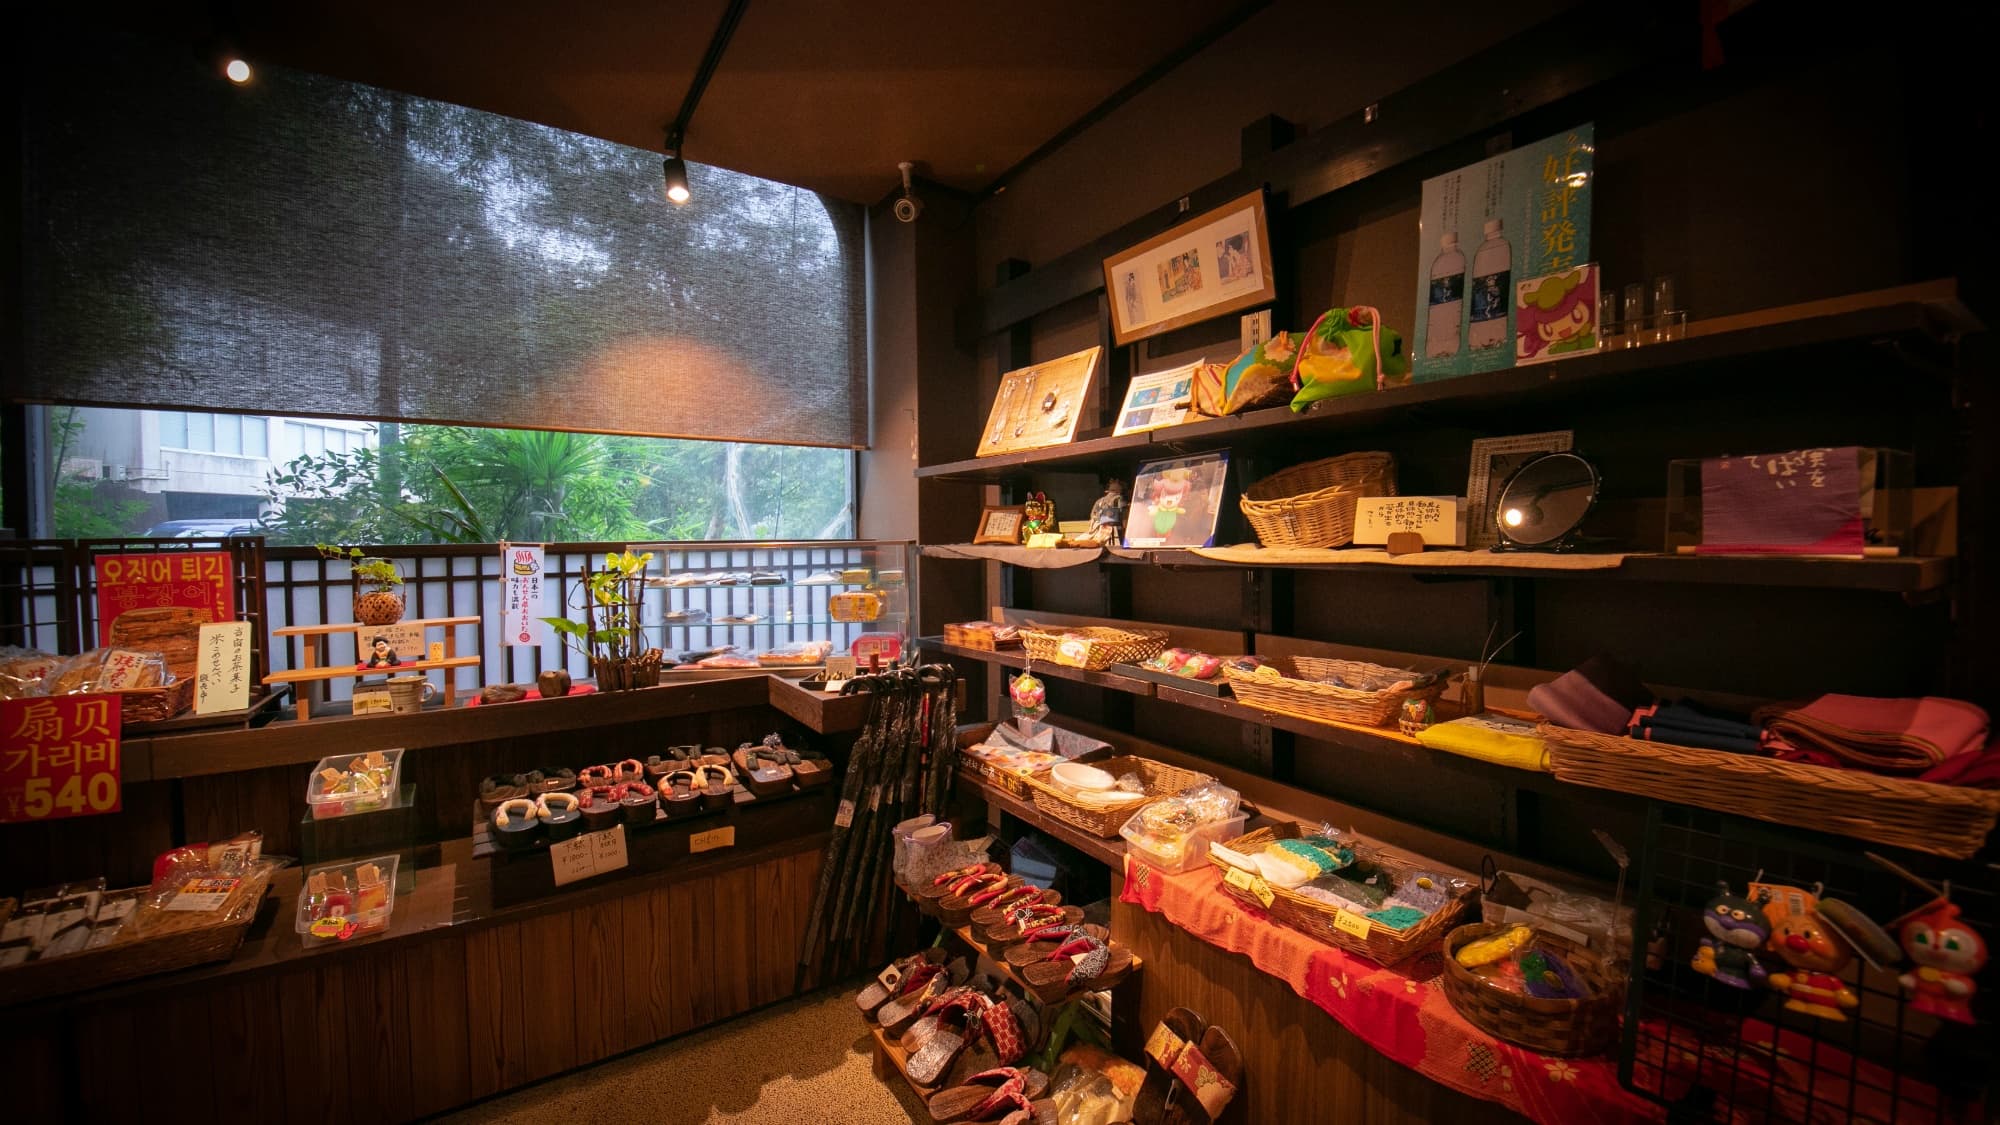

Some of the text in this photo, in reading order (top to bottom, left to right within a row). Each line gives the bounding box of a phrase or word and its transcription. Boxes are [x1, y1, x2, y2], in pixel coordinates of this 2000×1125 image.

[531, 577, 539, 599] 日本一の
[4, 738, 117, 776] 가리비
